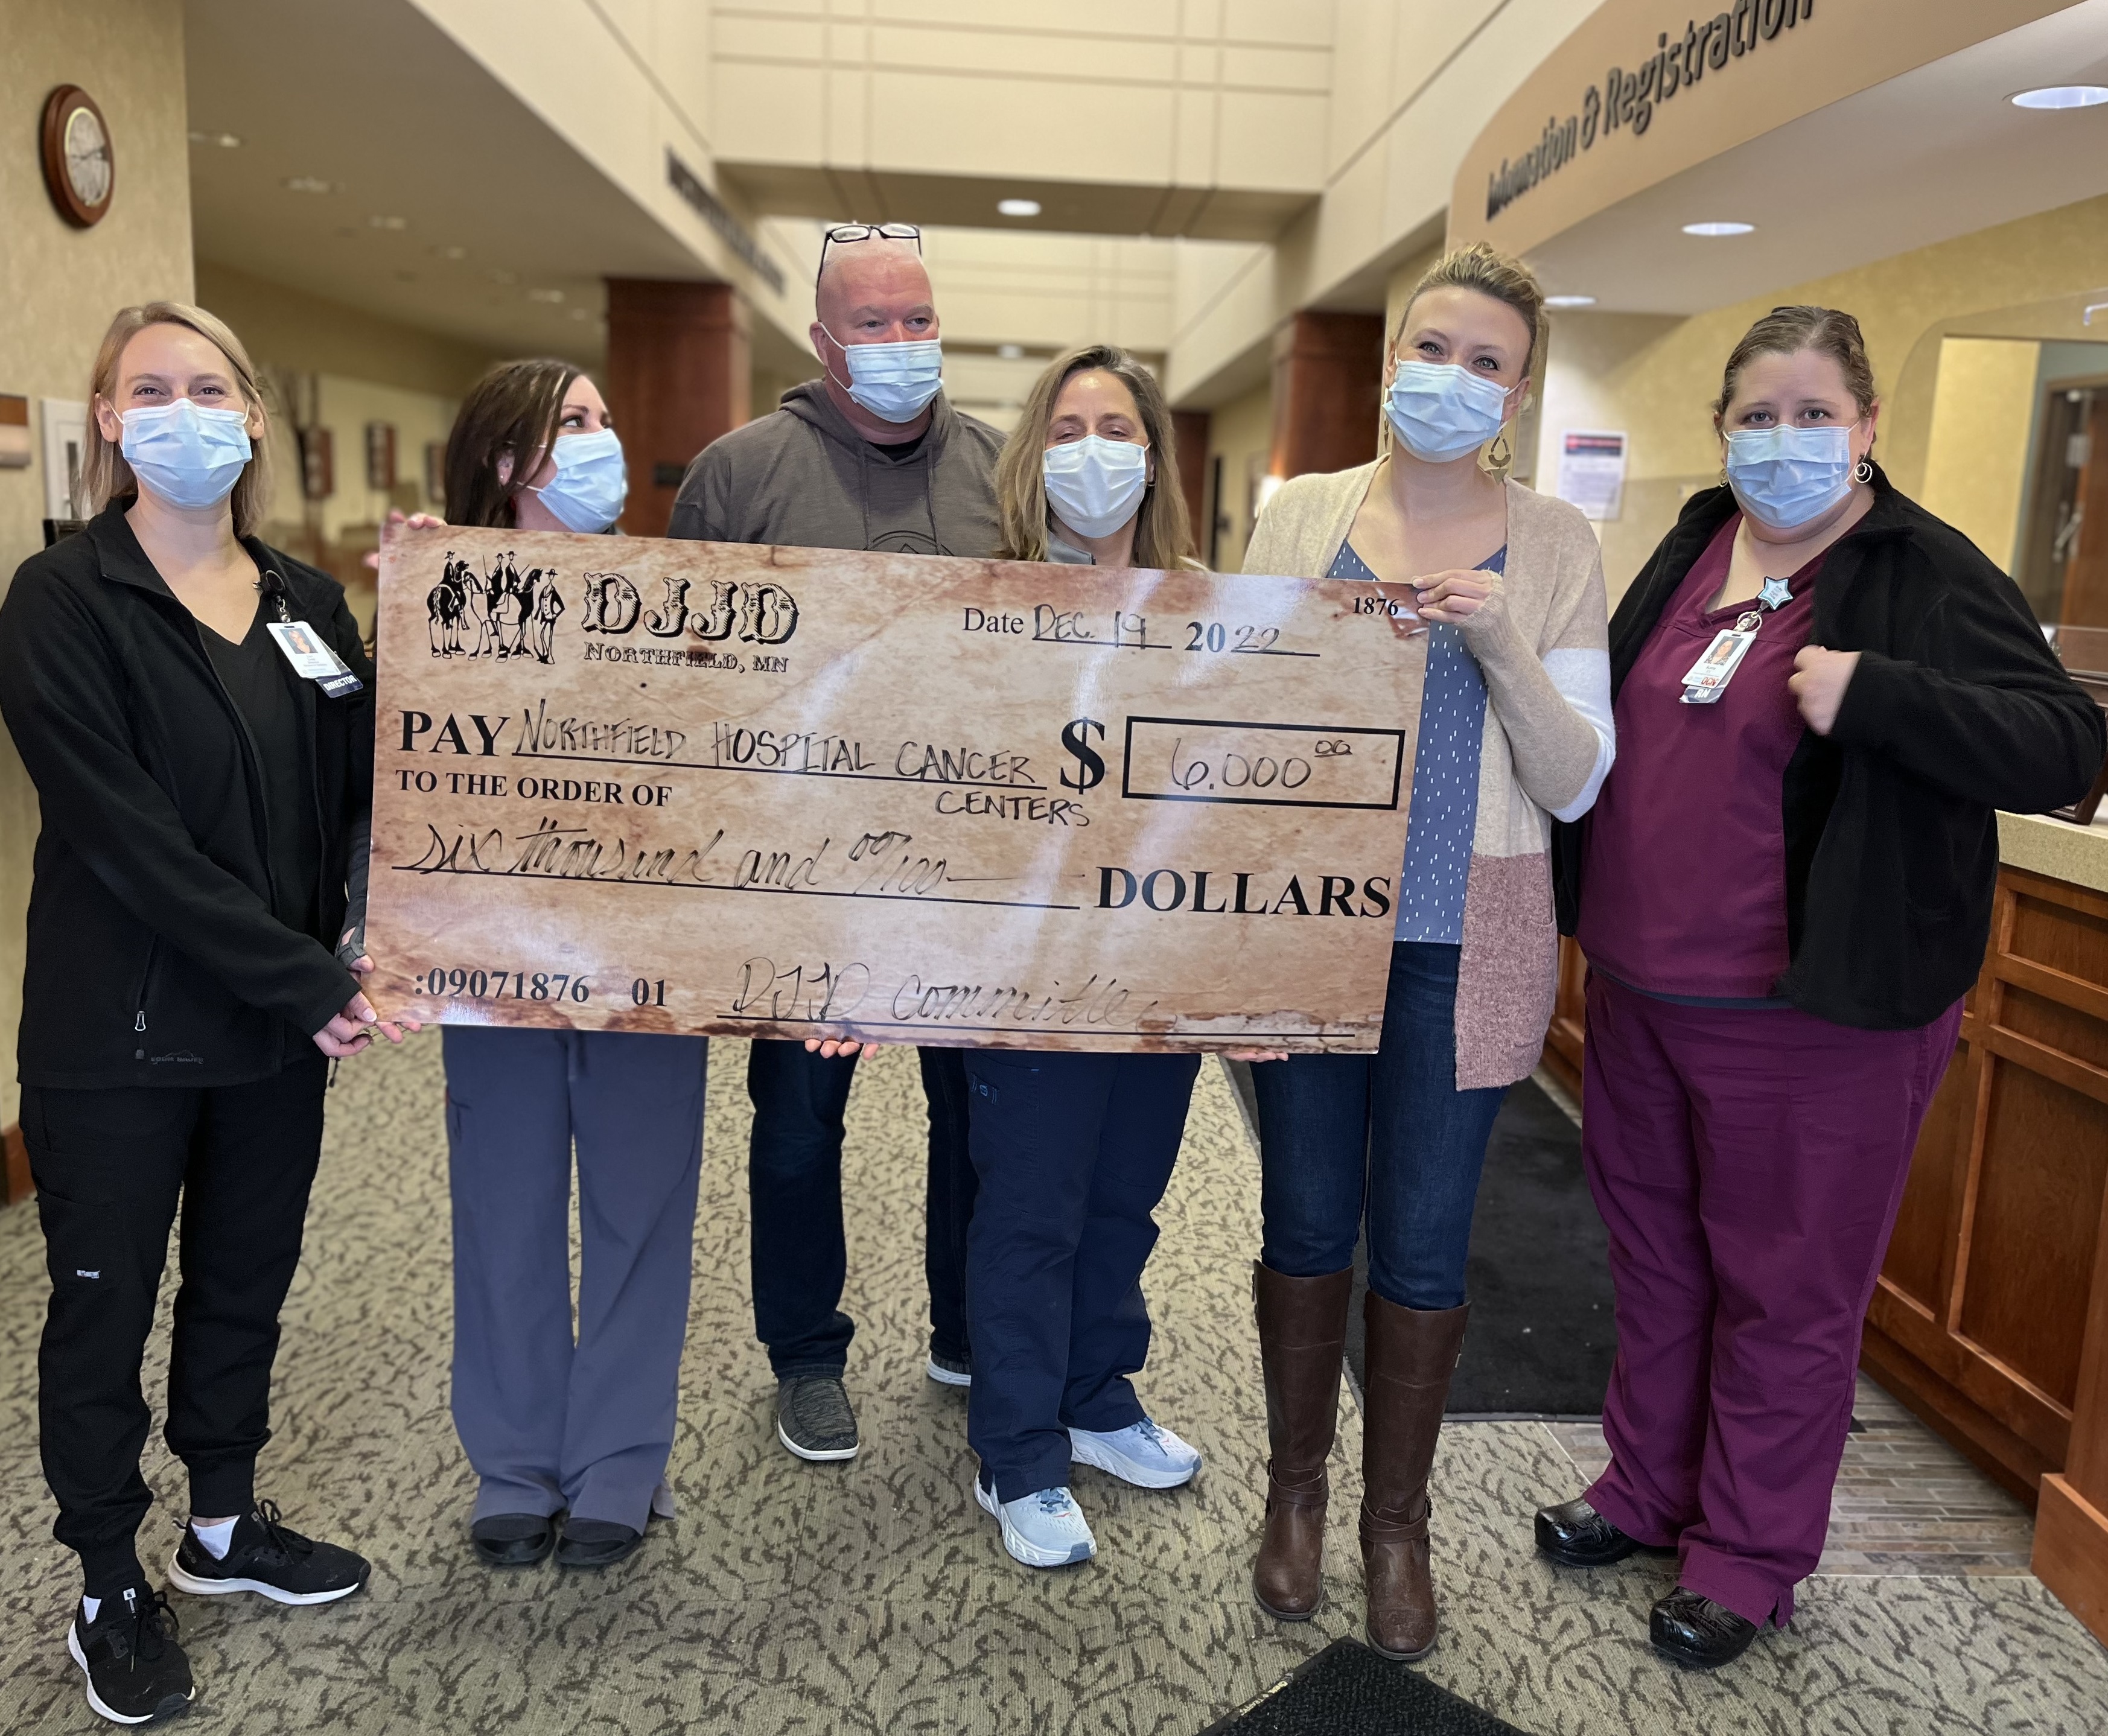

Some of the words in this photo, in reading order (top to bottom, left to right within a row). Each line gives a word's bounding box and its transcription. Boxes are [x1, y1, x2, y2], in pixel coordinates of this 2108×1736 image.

[1581, 85, 1600, 150] &
[582, 572, 800, 645] DJJD
[1352, 596, 1399, 617] 1876
[962, 607, 1024, 635] Date
[1114, 611, 1146, 650] 19
[584, 641, 745, 673] NORTHFIELD,
[752, 656, 789, 673] MN
[323, 675, 357, 691] DIRECTOR
[1694, 689, 1711, 698] RN
[396, 709, 511, 757] PAY
[516, 698, 687, 760] NORTHFIELD
[710, 722, 876, 773] HOSPITAL
[895, 740, 1036, 784] CANCER
[1059, 716, 1106, 796] $
[395, 769, 438, 793] TO
[445, 772, 508, 798] THE
[517, 776, 624, 803] ORDER
[632, 783, 673, 808] OF
[935, 790, 1090, 827] CENTERS
[733, 838, 831, 890] and
[1094, 866, 1392, 918] DOLLARS
[632, 978, 667, 1007] 01
